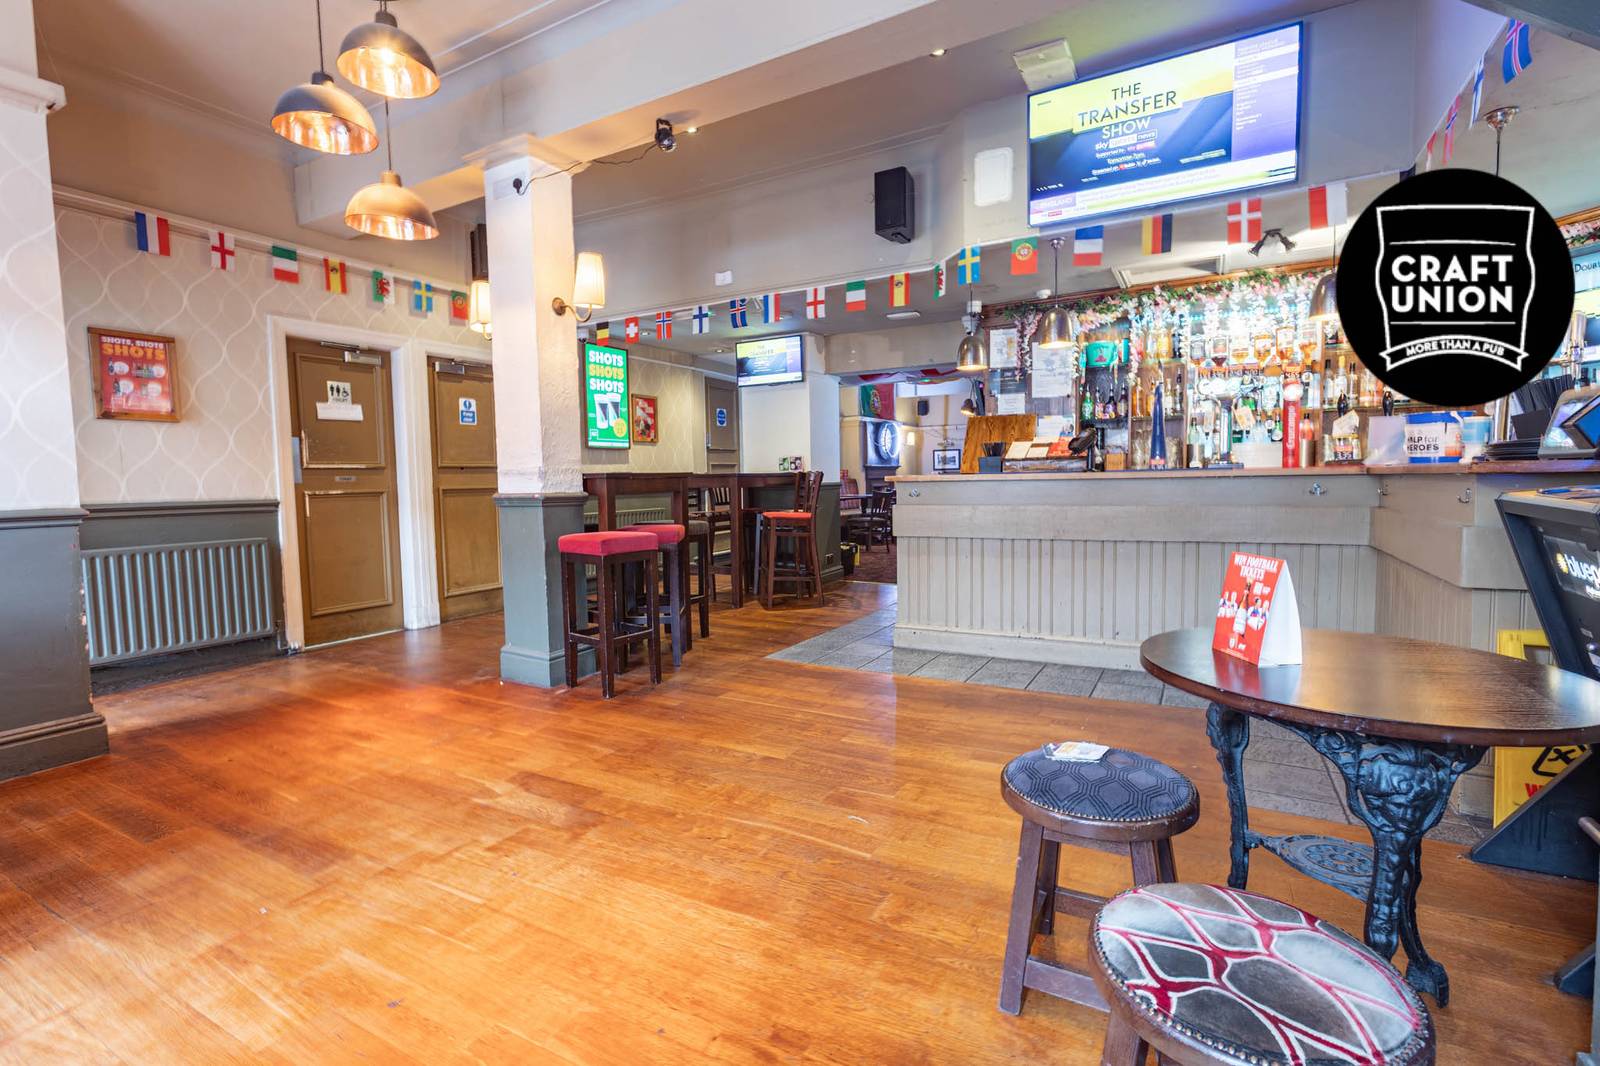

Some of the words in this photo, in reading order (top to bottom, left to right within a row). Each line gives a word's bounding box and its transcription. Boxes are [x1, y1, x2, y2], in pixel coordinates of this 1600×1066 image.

[1111, 82, 1142, 101] THE
[1077, 90, 1177, 127] TRANSFER
[1101, 116, 1152, 139] SHOW
[102, 343, 165, 360] SHOTS
[589, 350, 623, 367] SHOTS
[589, 364, 624, 380] SHOTS
[590, 378, 624, 393] SHOTS
[1240, 565, 1266, 581] TICKETS
[1247, 556, 1278, 573] FOOTBALL
